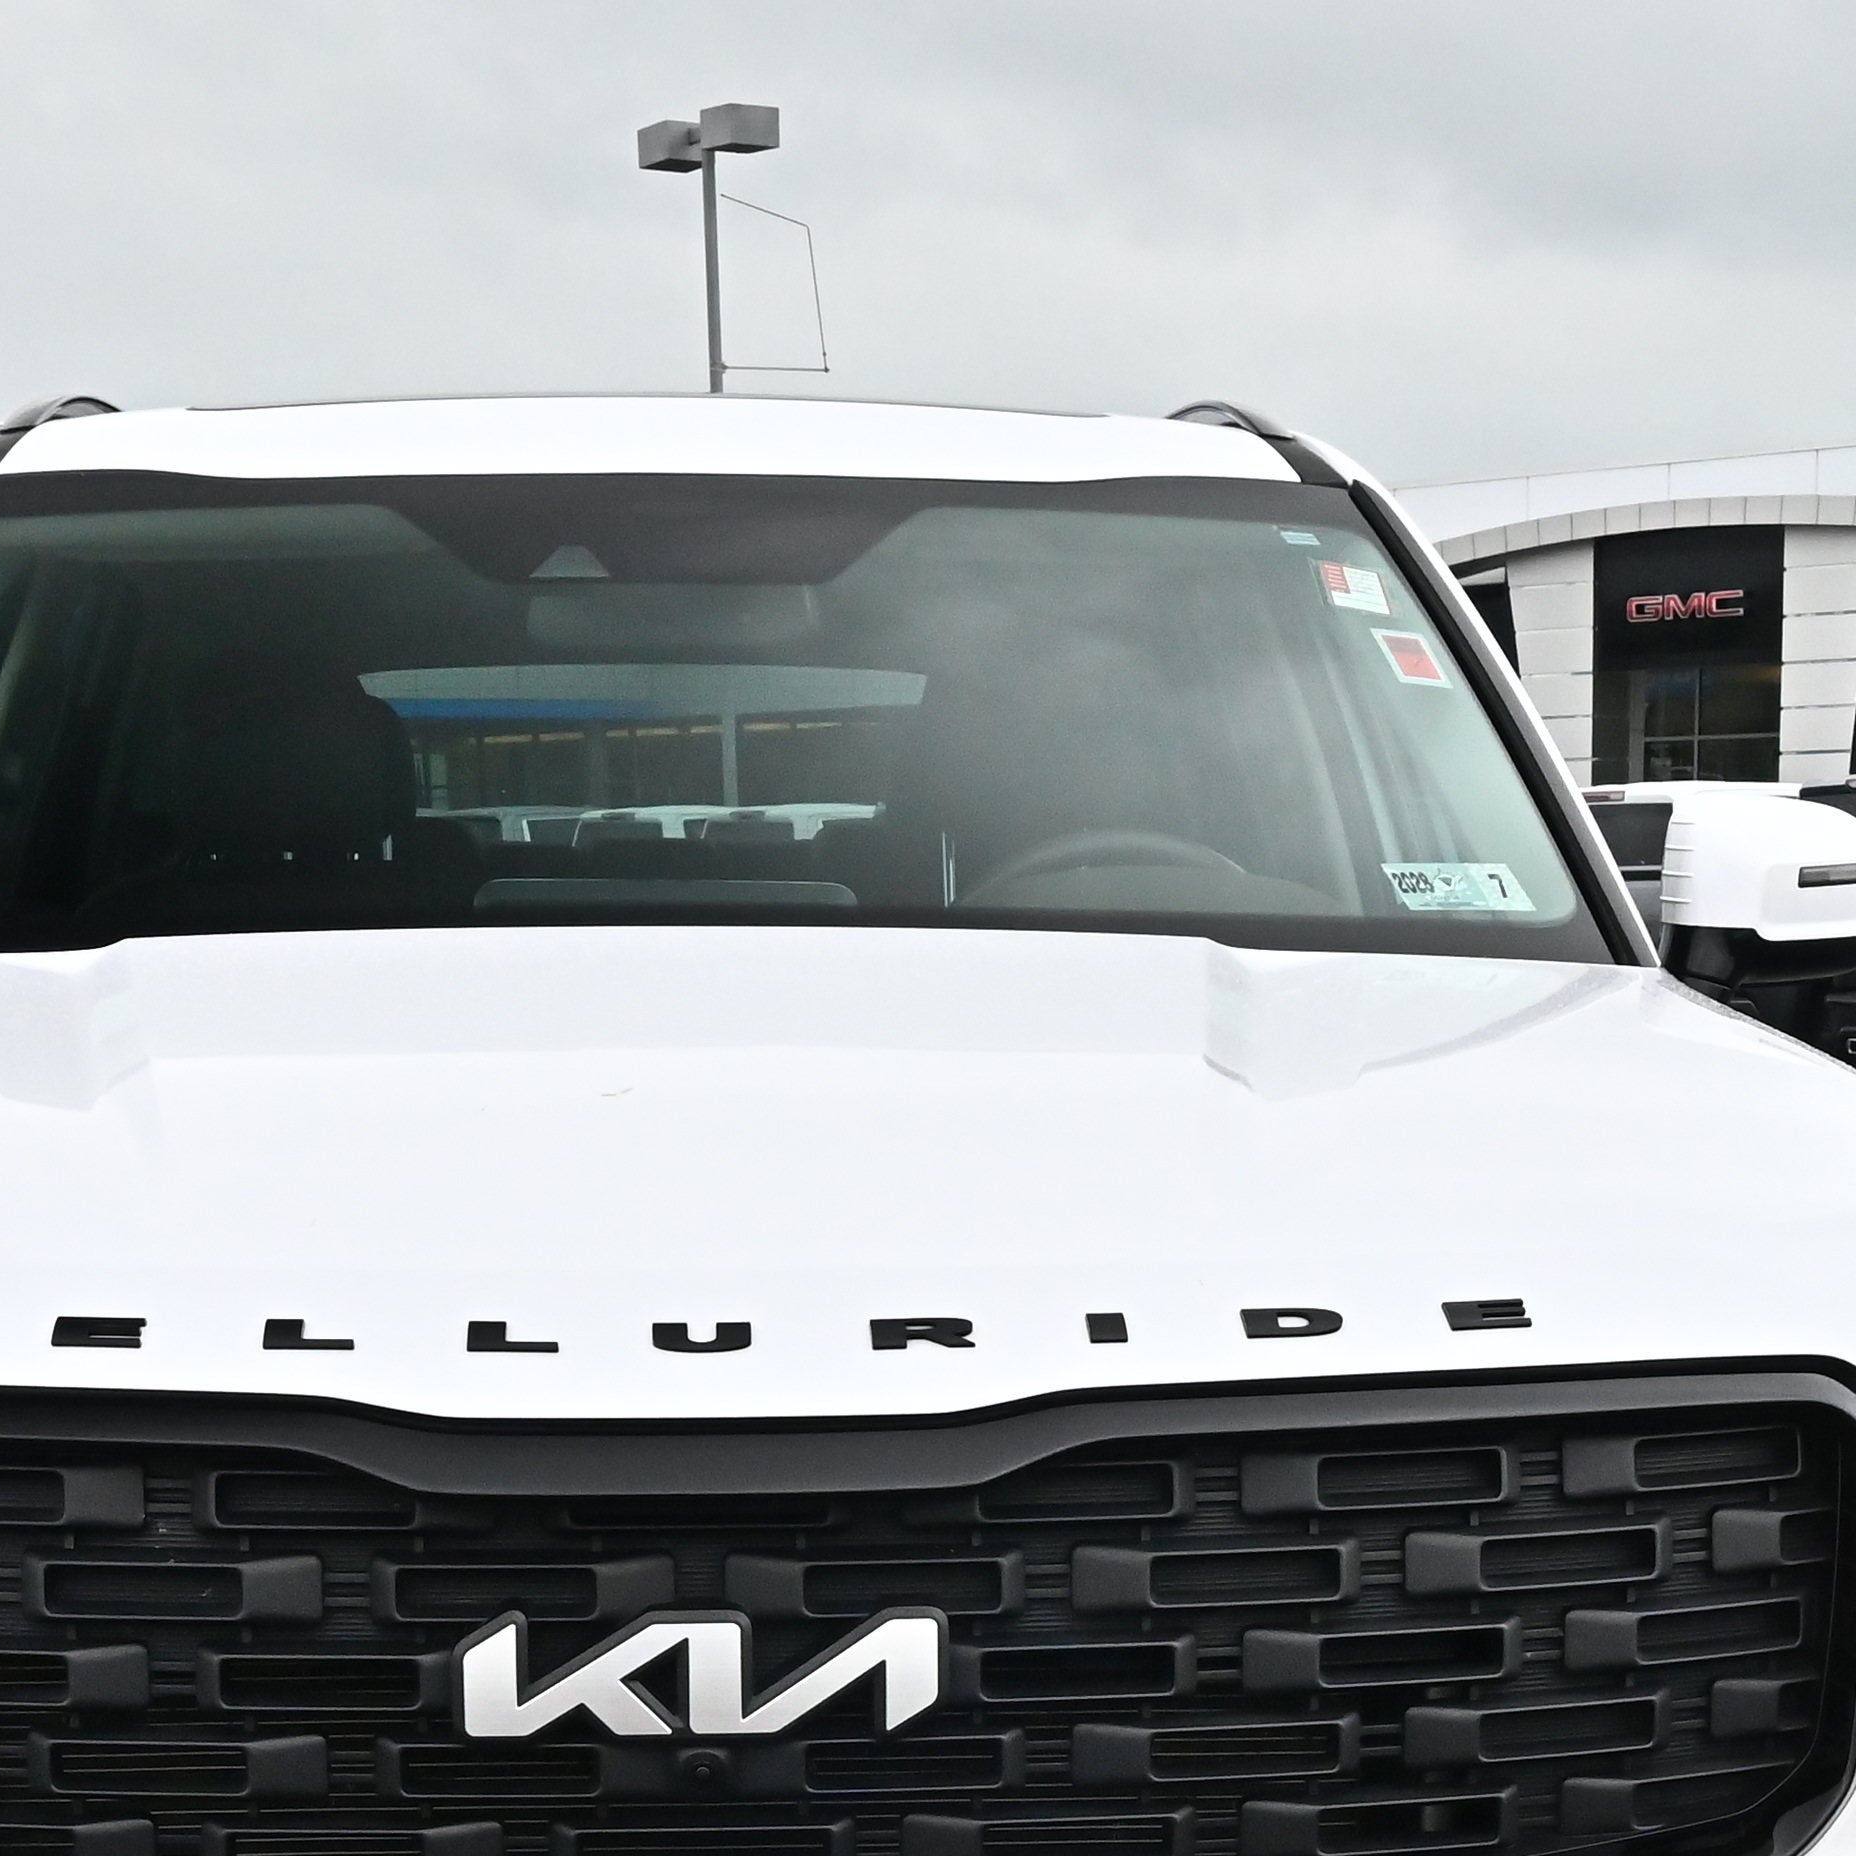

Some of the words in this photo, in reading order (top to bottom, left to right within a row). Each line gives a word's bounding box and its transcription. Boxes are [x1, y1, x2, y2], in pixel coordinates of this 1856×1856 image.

[1626, 589, 1744, 623] GMC
[1487, 873, 1508, 899] 7
[461, 1616, 941, 1738] KIA
